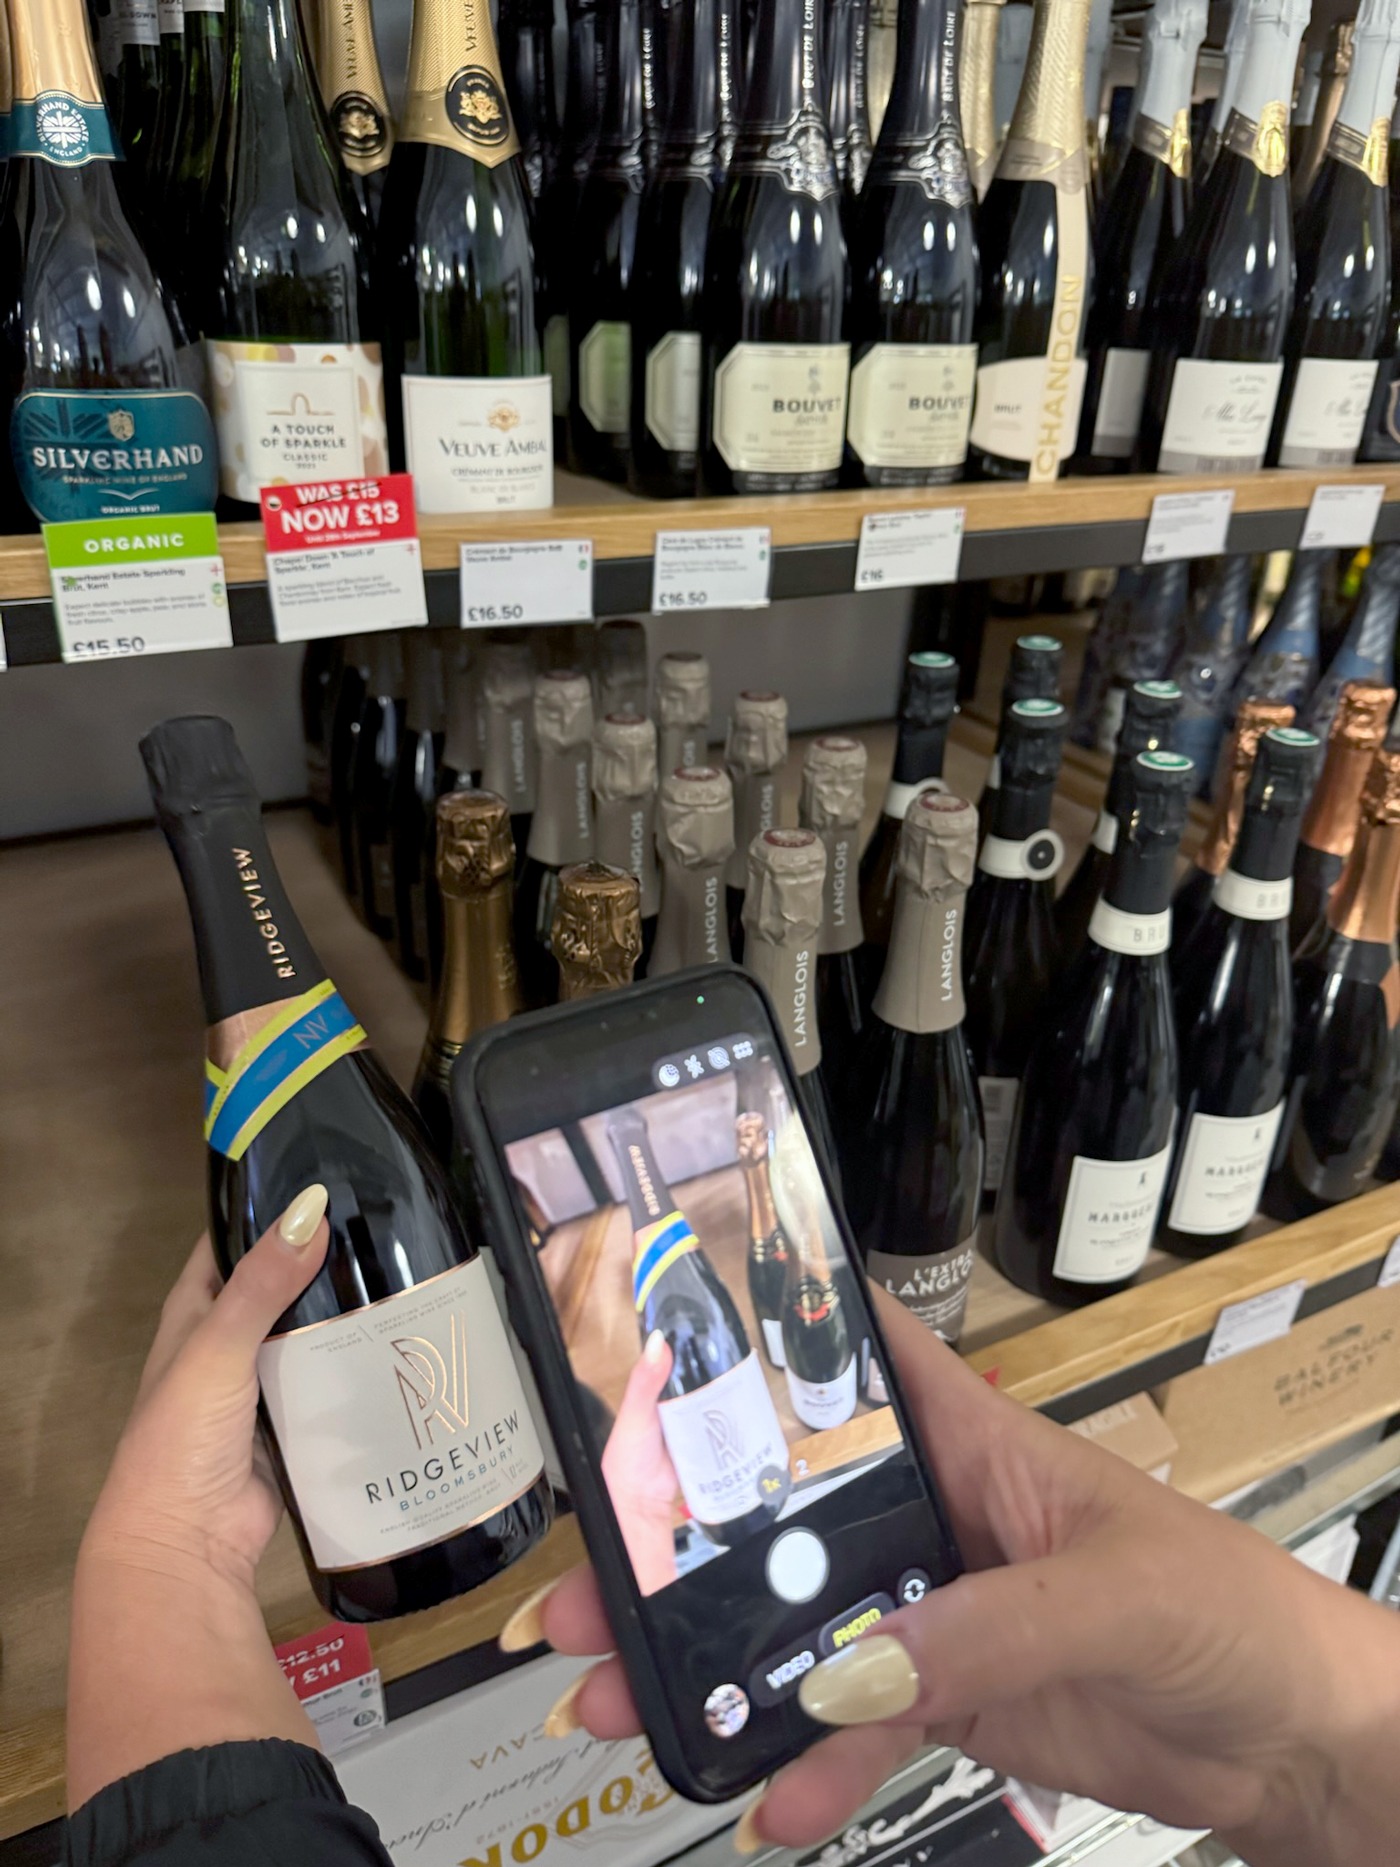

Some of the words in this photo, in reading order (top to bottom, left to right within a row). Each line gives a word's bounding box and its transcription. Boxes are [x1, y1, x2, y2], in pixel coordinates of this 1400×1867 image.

[943, 11, 956, 47] LOIRE
[801, 55, 815, 88] BRUT
[941, 70, 954, 102] BRUT
[71, 108, 89, 143] ESTATE
[49, 145, 83, 157] ENGLAND
[1035, 274, 1082, 475] CHANDON
[261, 438, 279, 449] OF
[284, 438, 347, 449] SPARKLE
[271, 425, 282, 435] A
[286, 425, 335, 436] TOUCH
[32, 443, 204, 471] SILVERHAND
[438, 437, 500, 458] VEUVE
[295, 482, 345, 504] WAS
[347, 480, 381, 500] £15
[100, 506, 138, 514] ORGANIC
[280, 504, 350, 534] NOW
[355, 500, 400, 527] £13
[83, 532, 185, 554] ORGANIC
[112, 569, 140, 581] Estate
[143, 568, 186, 581] Sparkling
[467, 604, 524, 622] £16.50
[72, 636, 146, 658] £15.50
[832, 841, 848, 926] LANGLOIS
[231, 847, 297, 979] RIDGEVIEW
[940, 909, 958, 1002] LANGLOIS
[793, 950, 809, 1047] LANGLOIS
[292, 1012, 330, 1050] NV
[913, 1248, 974, 1281] L'EXTRA
[365, 1410, 520, 1504] RIDGEVIEW
[399, 1445, 515, 1512] BLOOMSBURY
[832, 1607, 882, 1648] PHOTO
[302, 1658, 342, 1685] £11
[765, 1650, 815, 1690] VIDEO
